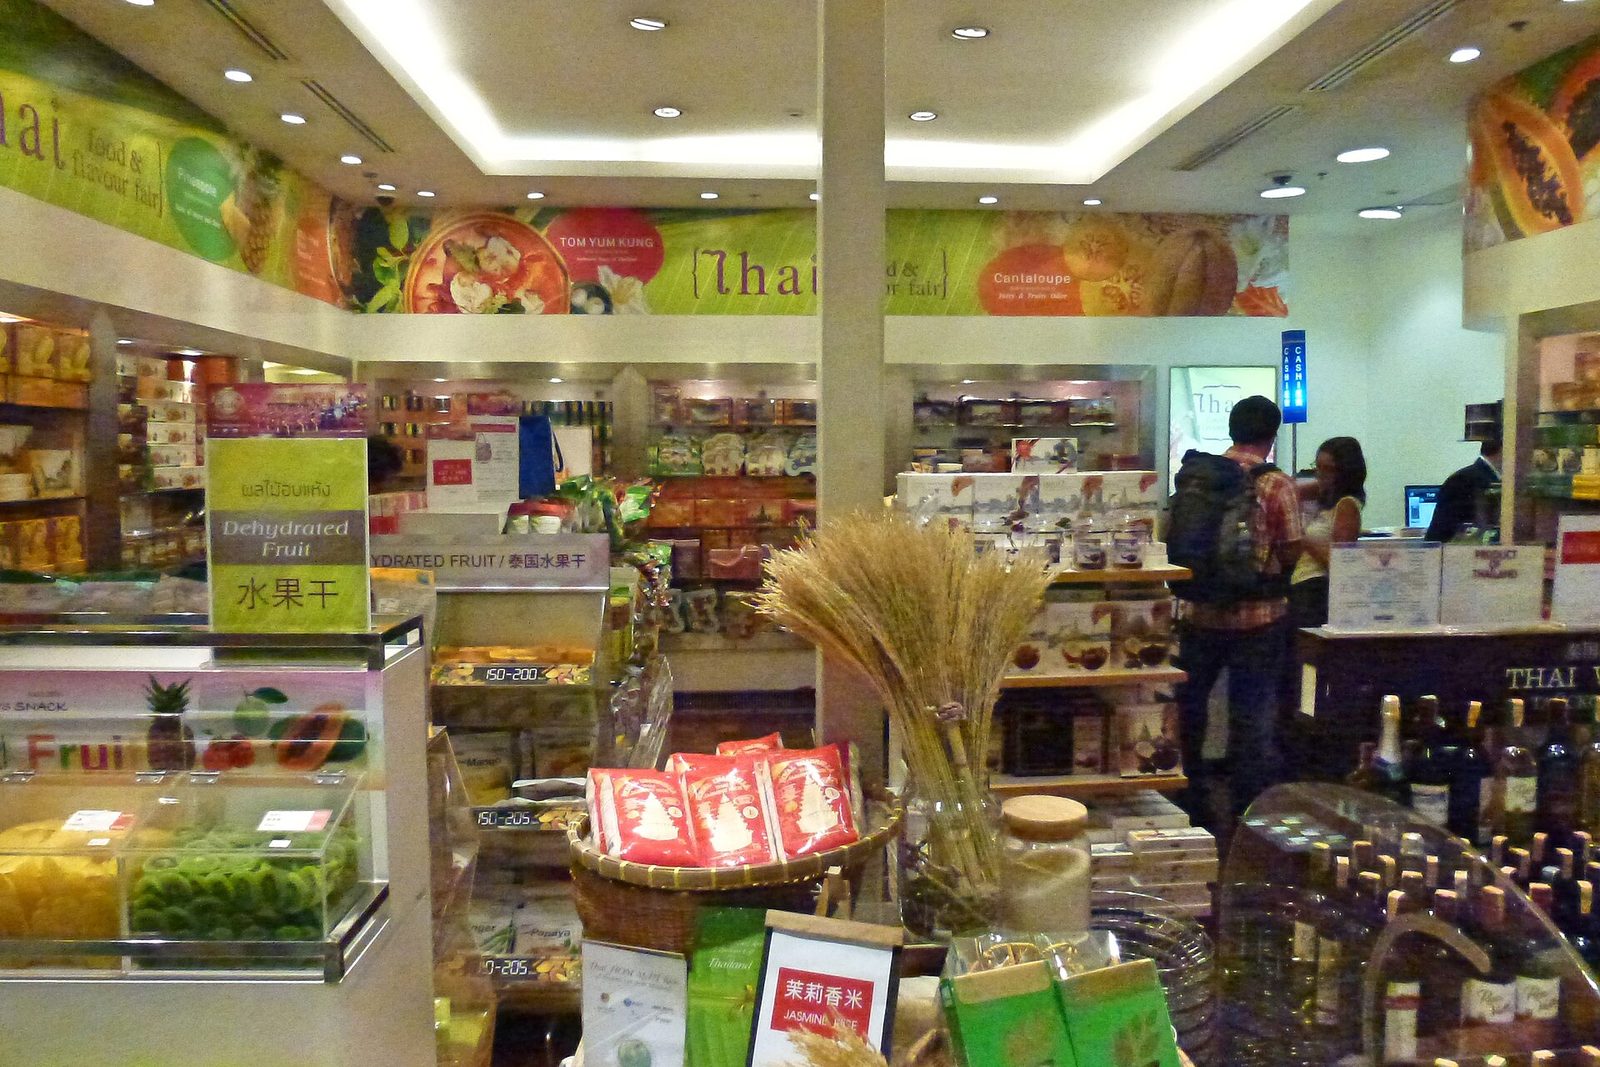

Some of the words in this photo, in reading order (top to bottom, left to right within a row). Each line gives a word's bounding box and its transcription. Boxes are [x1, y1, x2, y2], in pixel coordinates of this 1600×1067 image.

[129, 150, 142, 175] &
[560, 237, 586, 248] TOM
[589, 238, 616, 248] YUM
[619, 238, 654, 248] KUNG
[901, 262, 918, 278] &
[994, 272, 1072, 286] Cantaloupe
[909, 281, 939, 297] fair
[1193, 393, 1235, 413] Tha
[223, 520, 349, 539] Dehydrated
[262, 542, 311, 557] Fruit
[450, 554, 497, 568] FRUIT
[509, 553, 586, 569] 泰国水果干
[237, 577, 339, 610] 水果干
[486, 668, 538, 680] 150-200
[1505, 667, 1577, 689] THAI
[14, 702, 68, 711] SNACK
[478, 811, 530, 825] 150-205
[708, 957, 752, 970] Thailand
[784, 979, 862, 1010] 茉莉香米
